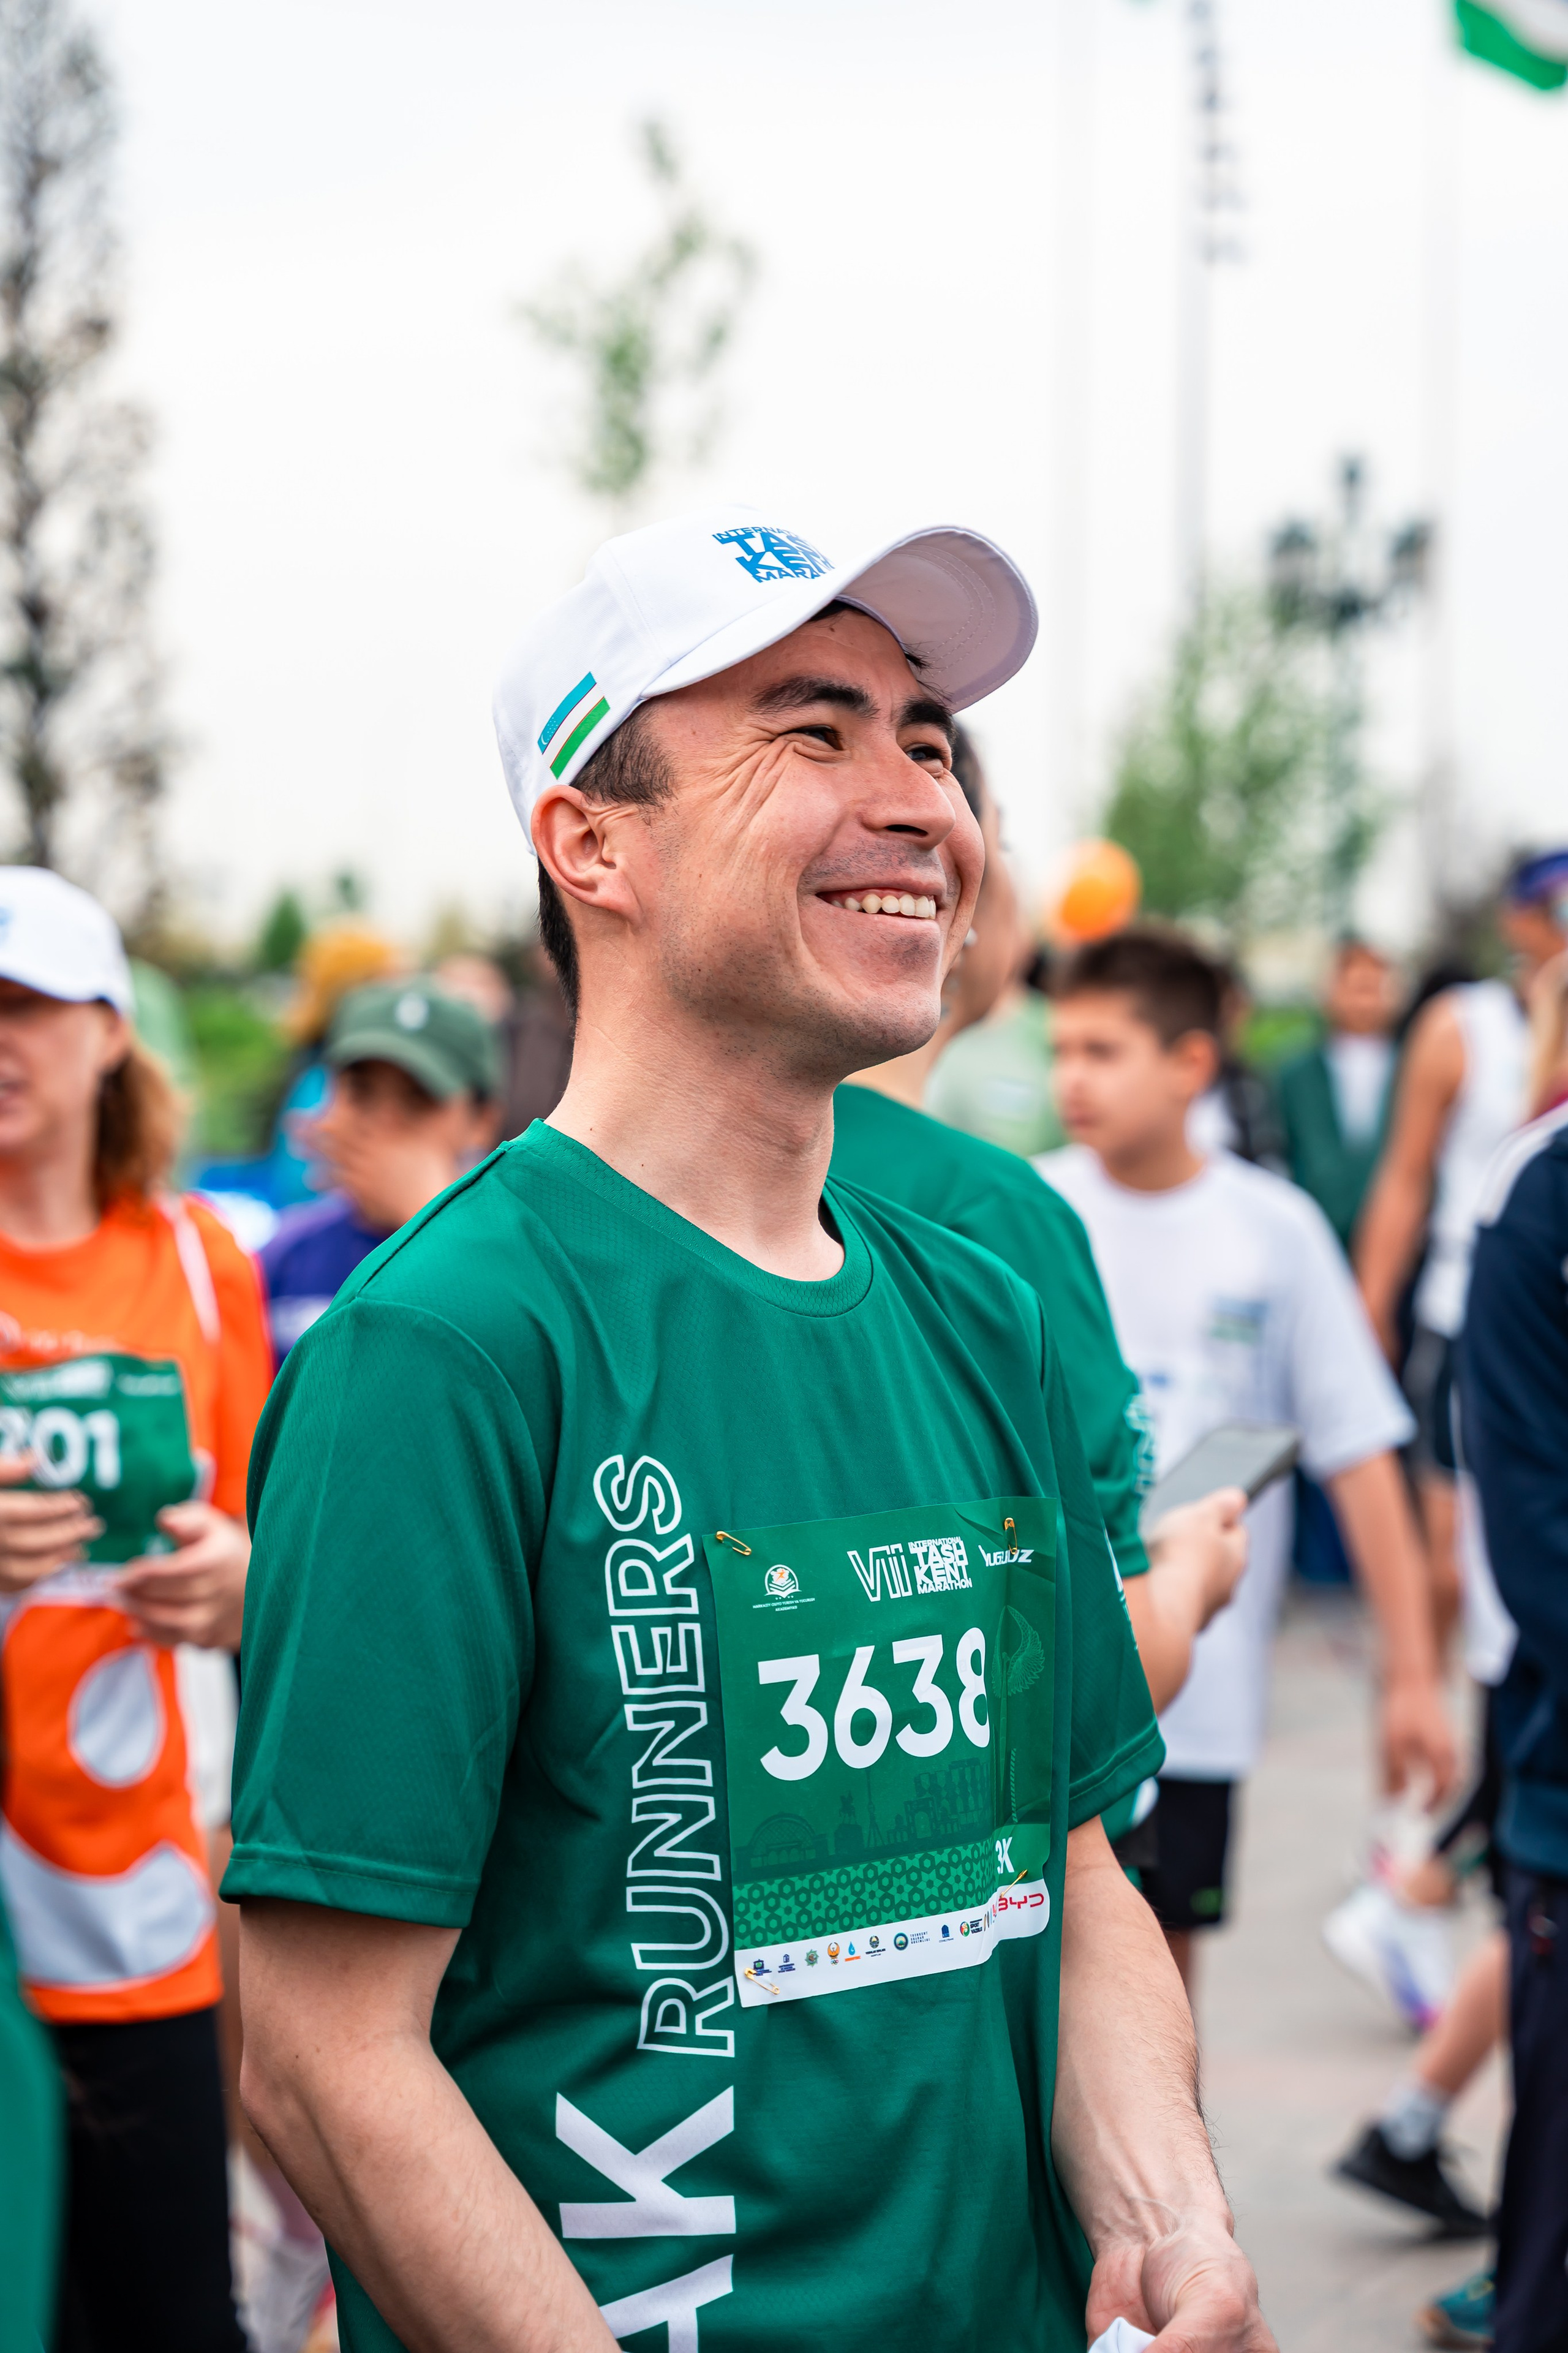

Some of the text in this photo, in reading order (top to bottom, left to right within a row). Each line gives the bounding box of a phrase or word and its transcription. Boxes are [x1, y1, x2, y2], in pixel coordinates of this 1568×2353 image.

[711, 526, 799, 540] INTERNAT
[717, 532, 824, 558] TAS
[735, 550, 835, 575] KEN
[753, 567, 821, 583] MARA
[908, 1536, 962, 1549] INTERNATIONAL
[909, 1540, 969, 1567] TASH
[913, 1562, 968, 1585] KENT
[916, 1577, 973, 1595] MARATHON
[758, 1627, 990, 1781] 3638
[592, 1454, 735, 2058] RUNNERS
[998, 1893, 1044, 1911] BYD
